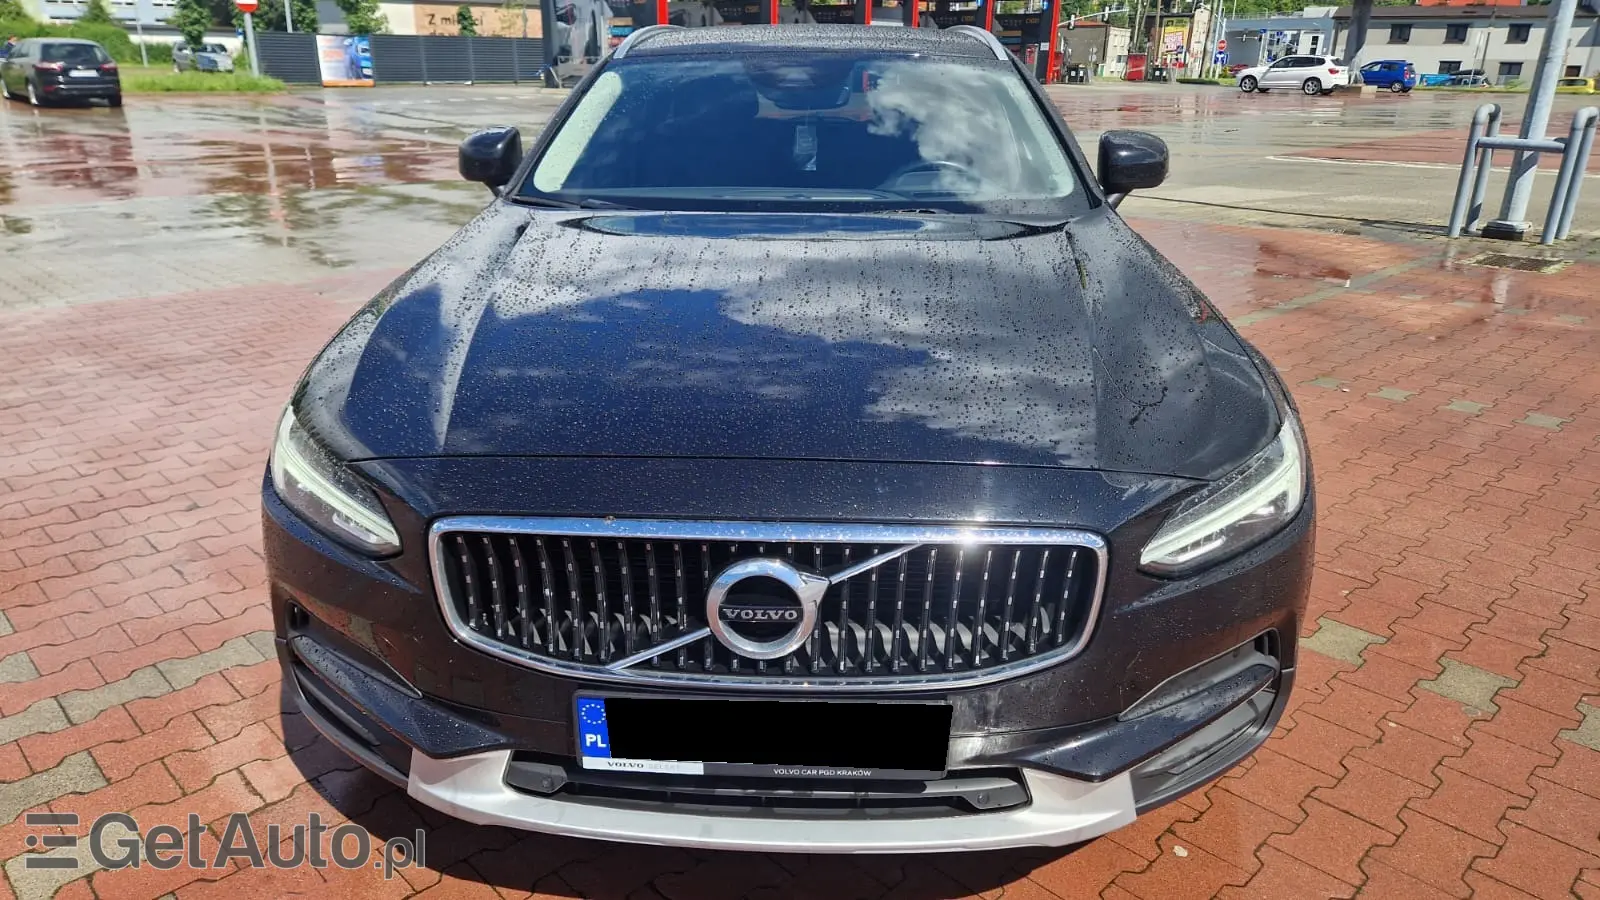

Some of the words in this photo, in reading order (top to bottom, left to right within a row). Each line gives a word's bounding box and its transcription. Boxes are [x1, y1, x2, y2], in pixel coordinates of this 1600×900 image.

[427, 13, 436, 26] Z
[722, 608, 798, 621] VOLVO
[585, 733, 607, 748] PL
[607, 761, 644, 769] VOLVO
[773, 768, 800, 776] VOLVO
[836, 769, 872, 777] KRAKÓW
